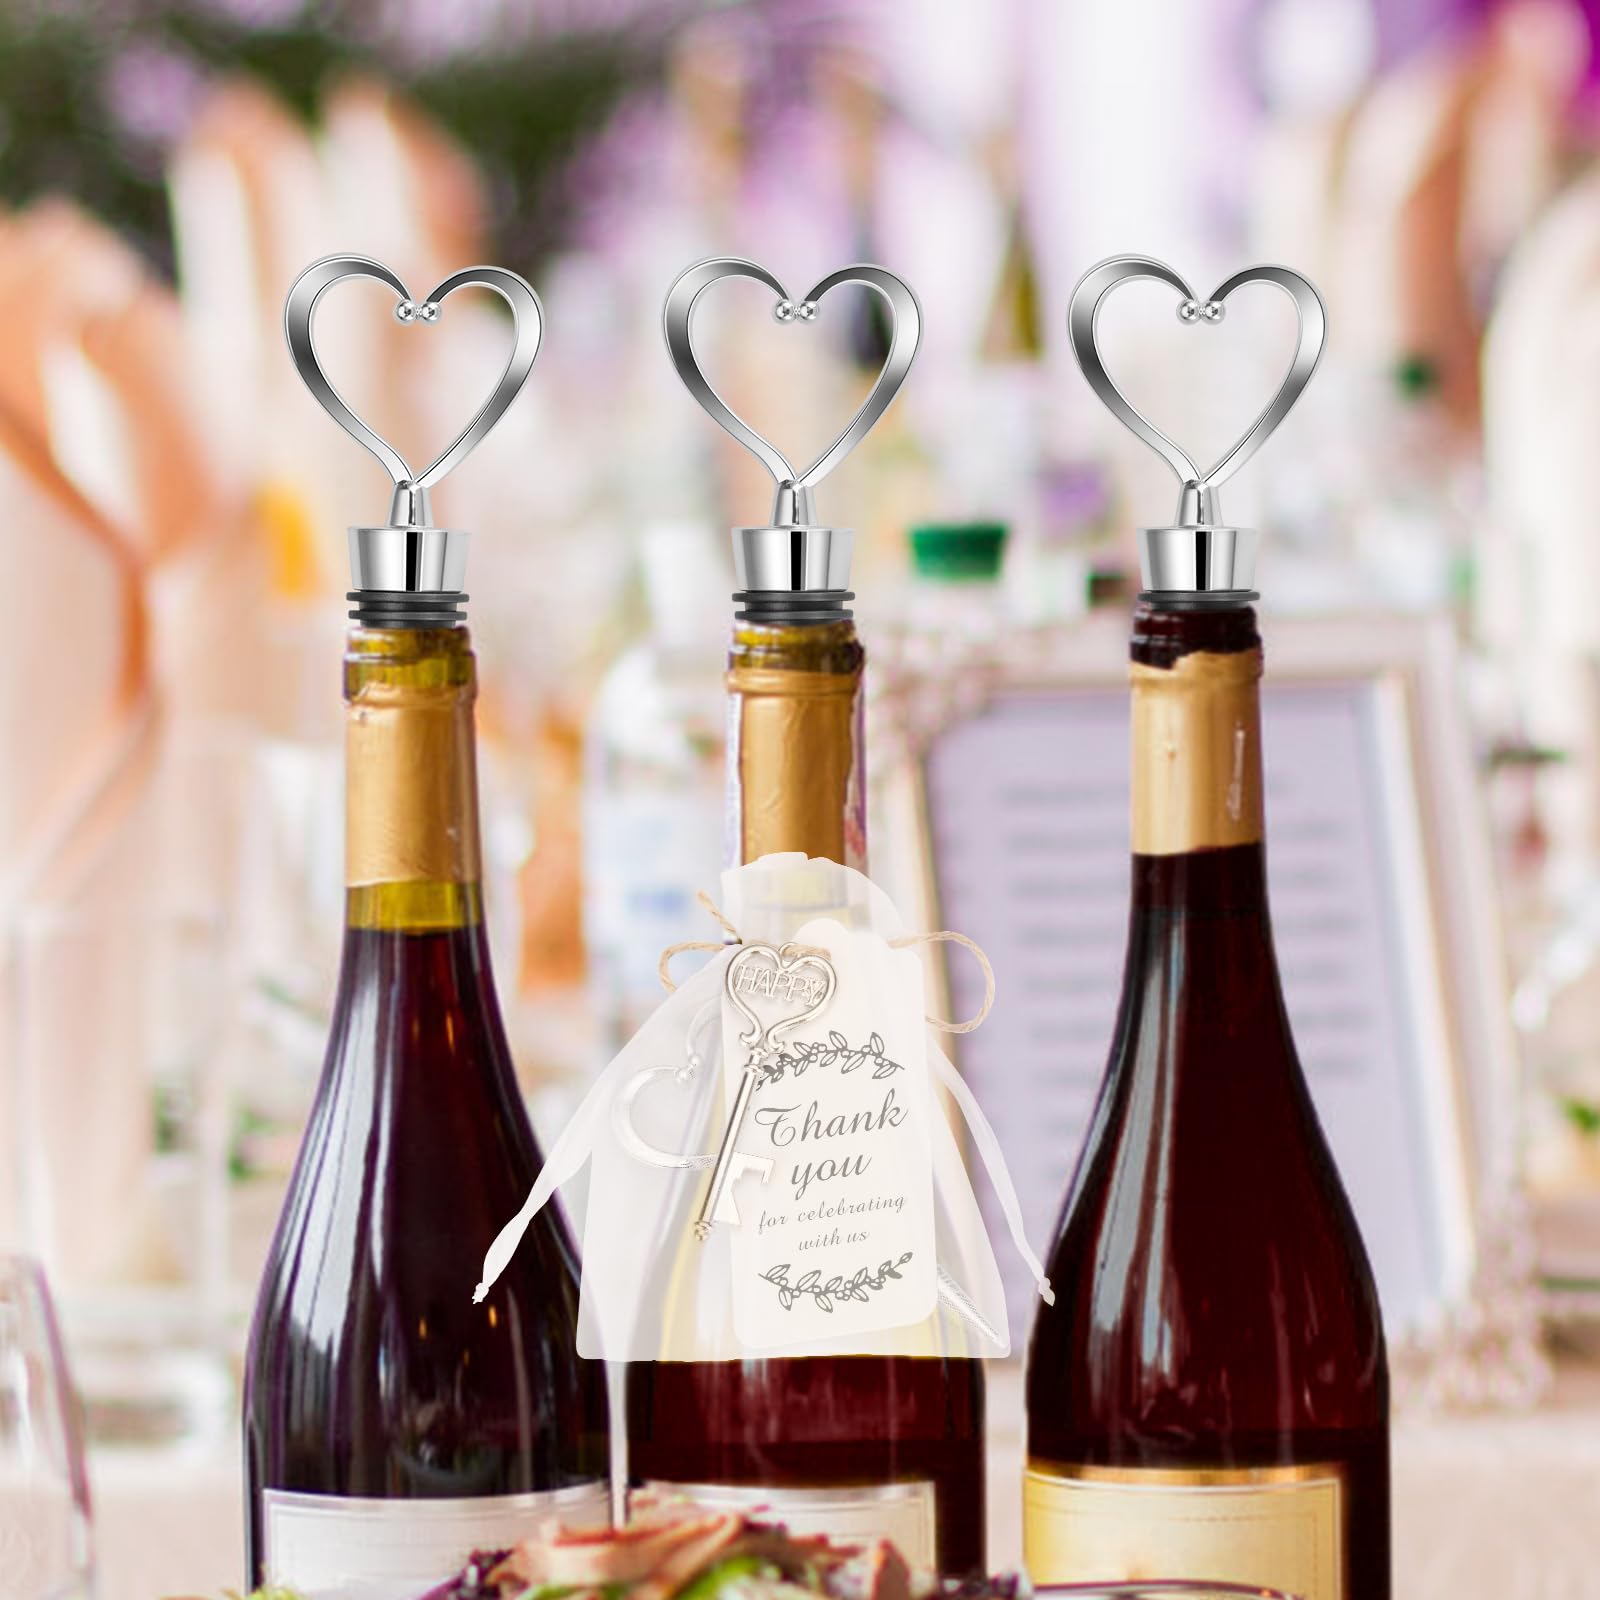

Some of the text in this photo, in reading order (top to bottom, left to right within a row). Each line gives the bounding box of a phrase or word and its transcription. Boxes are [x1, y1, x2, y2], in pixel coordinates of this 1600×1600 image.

[736, 964, 826, 1008] HAPPY
[755, 1088, 908, 1146] Thank
[791, 1154, 873, 1200] you
[758, 1196, 905, 1235] for celebrating
[798, 1227, 869, 1251] with us
